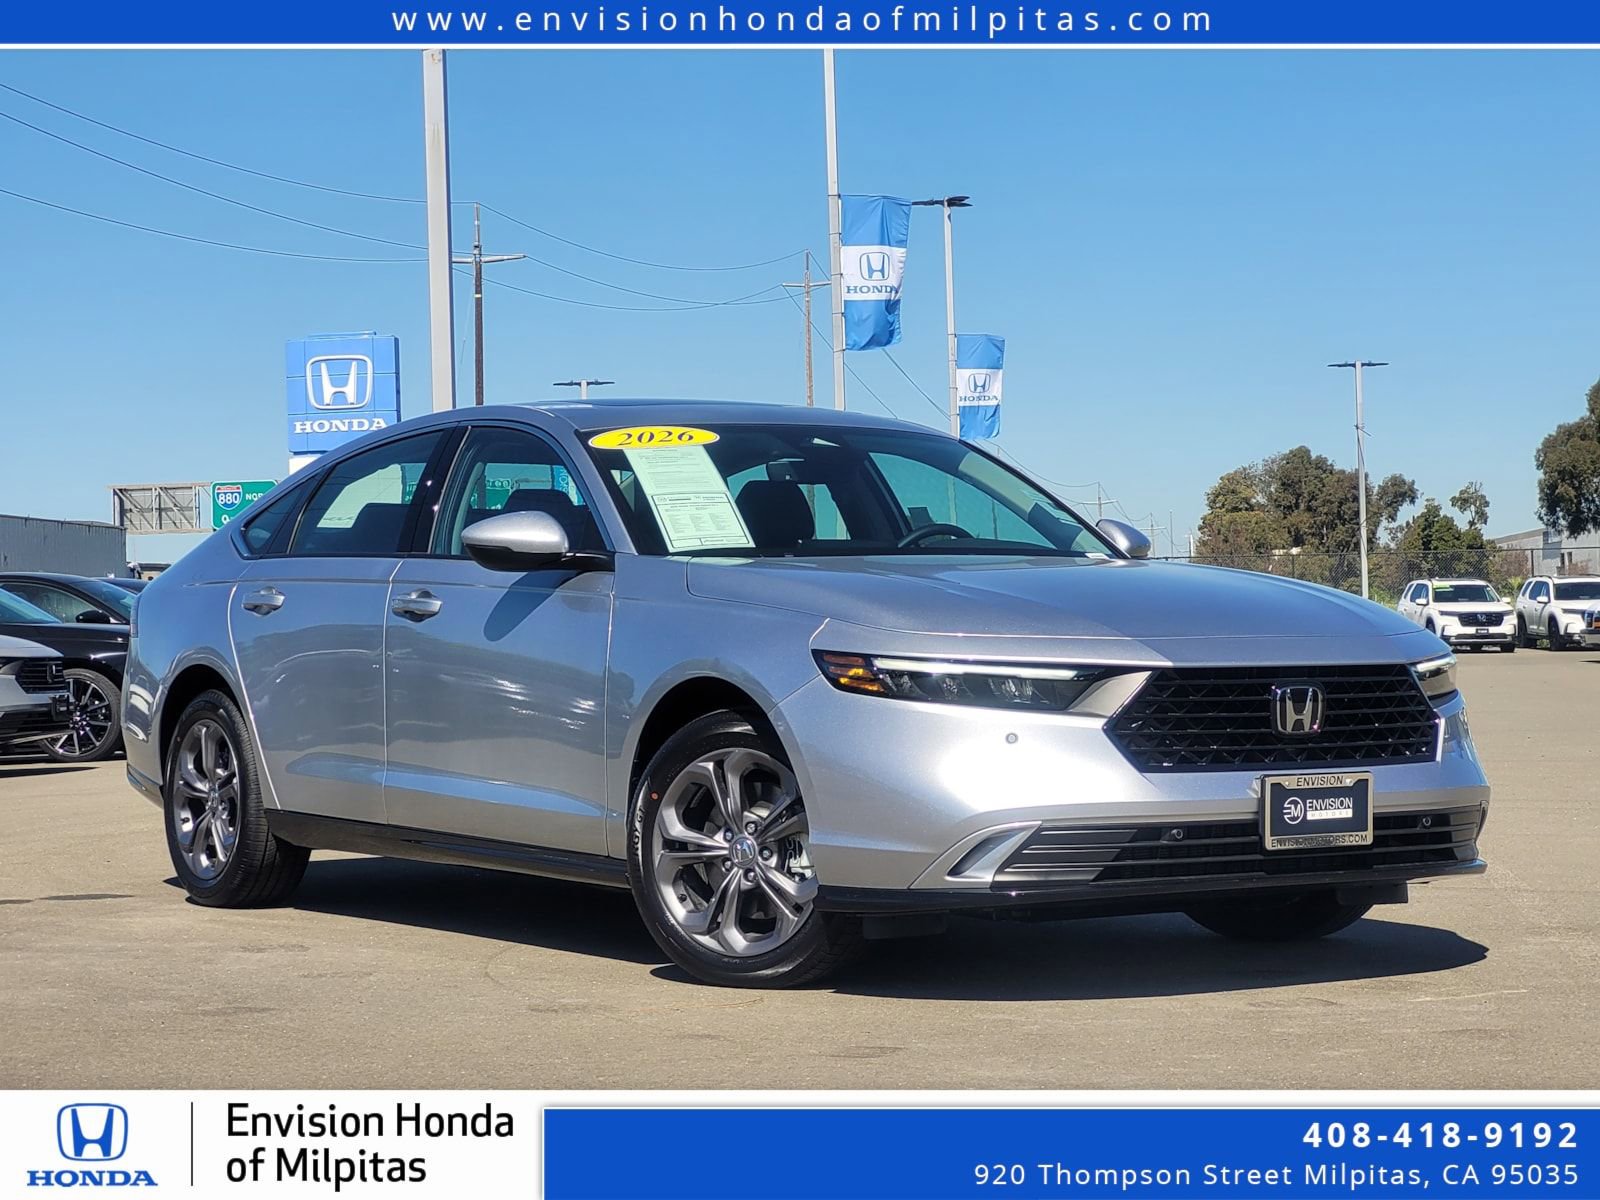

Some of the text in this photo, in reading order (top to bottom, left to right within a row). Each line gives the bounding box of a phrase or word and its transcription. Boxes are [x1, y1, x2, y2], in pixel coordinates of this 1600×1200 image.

[293, 418, 388, 434] HONDA
[616, 430, 695, 446] 2026
[218, 493, 240, 505] 880
[1296, 775, 1344, 787] ENVISION
[1306, 798, 1353, 811] ENVISION
